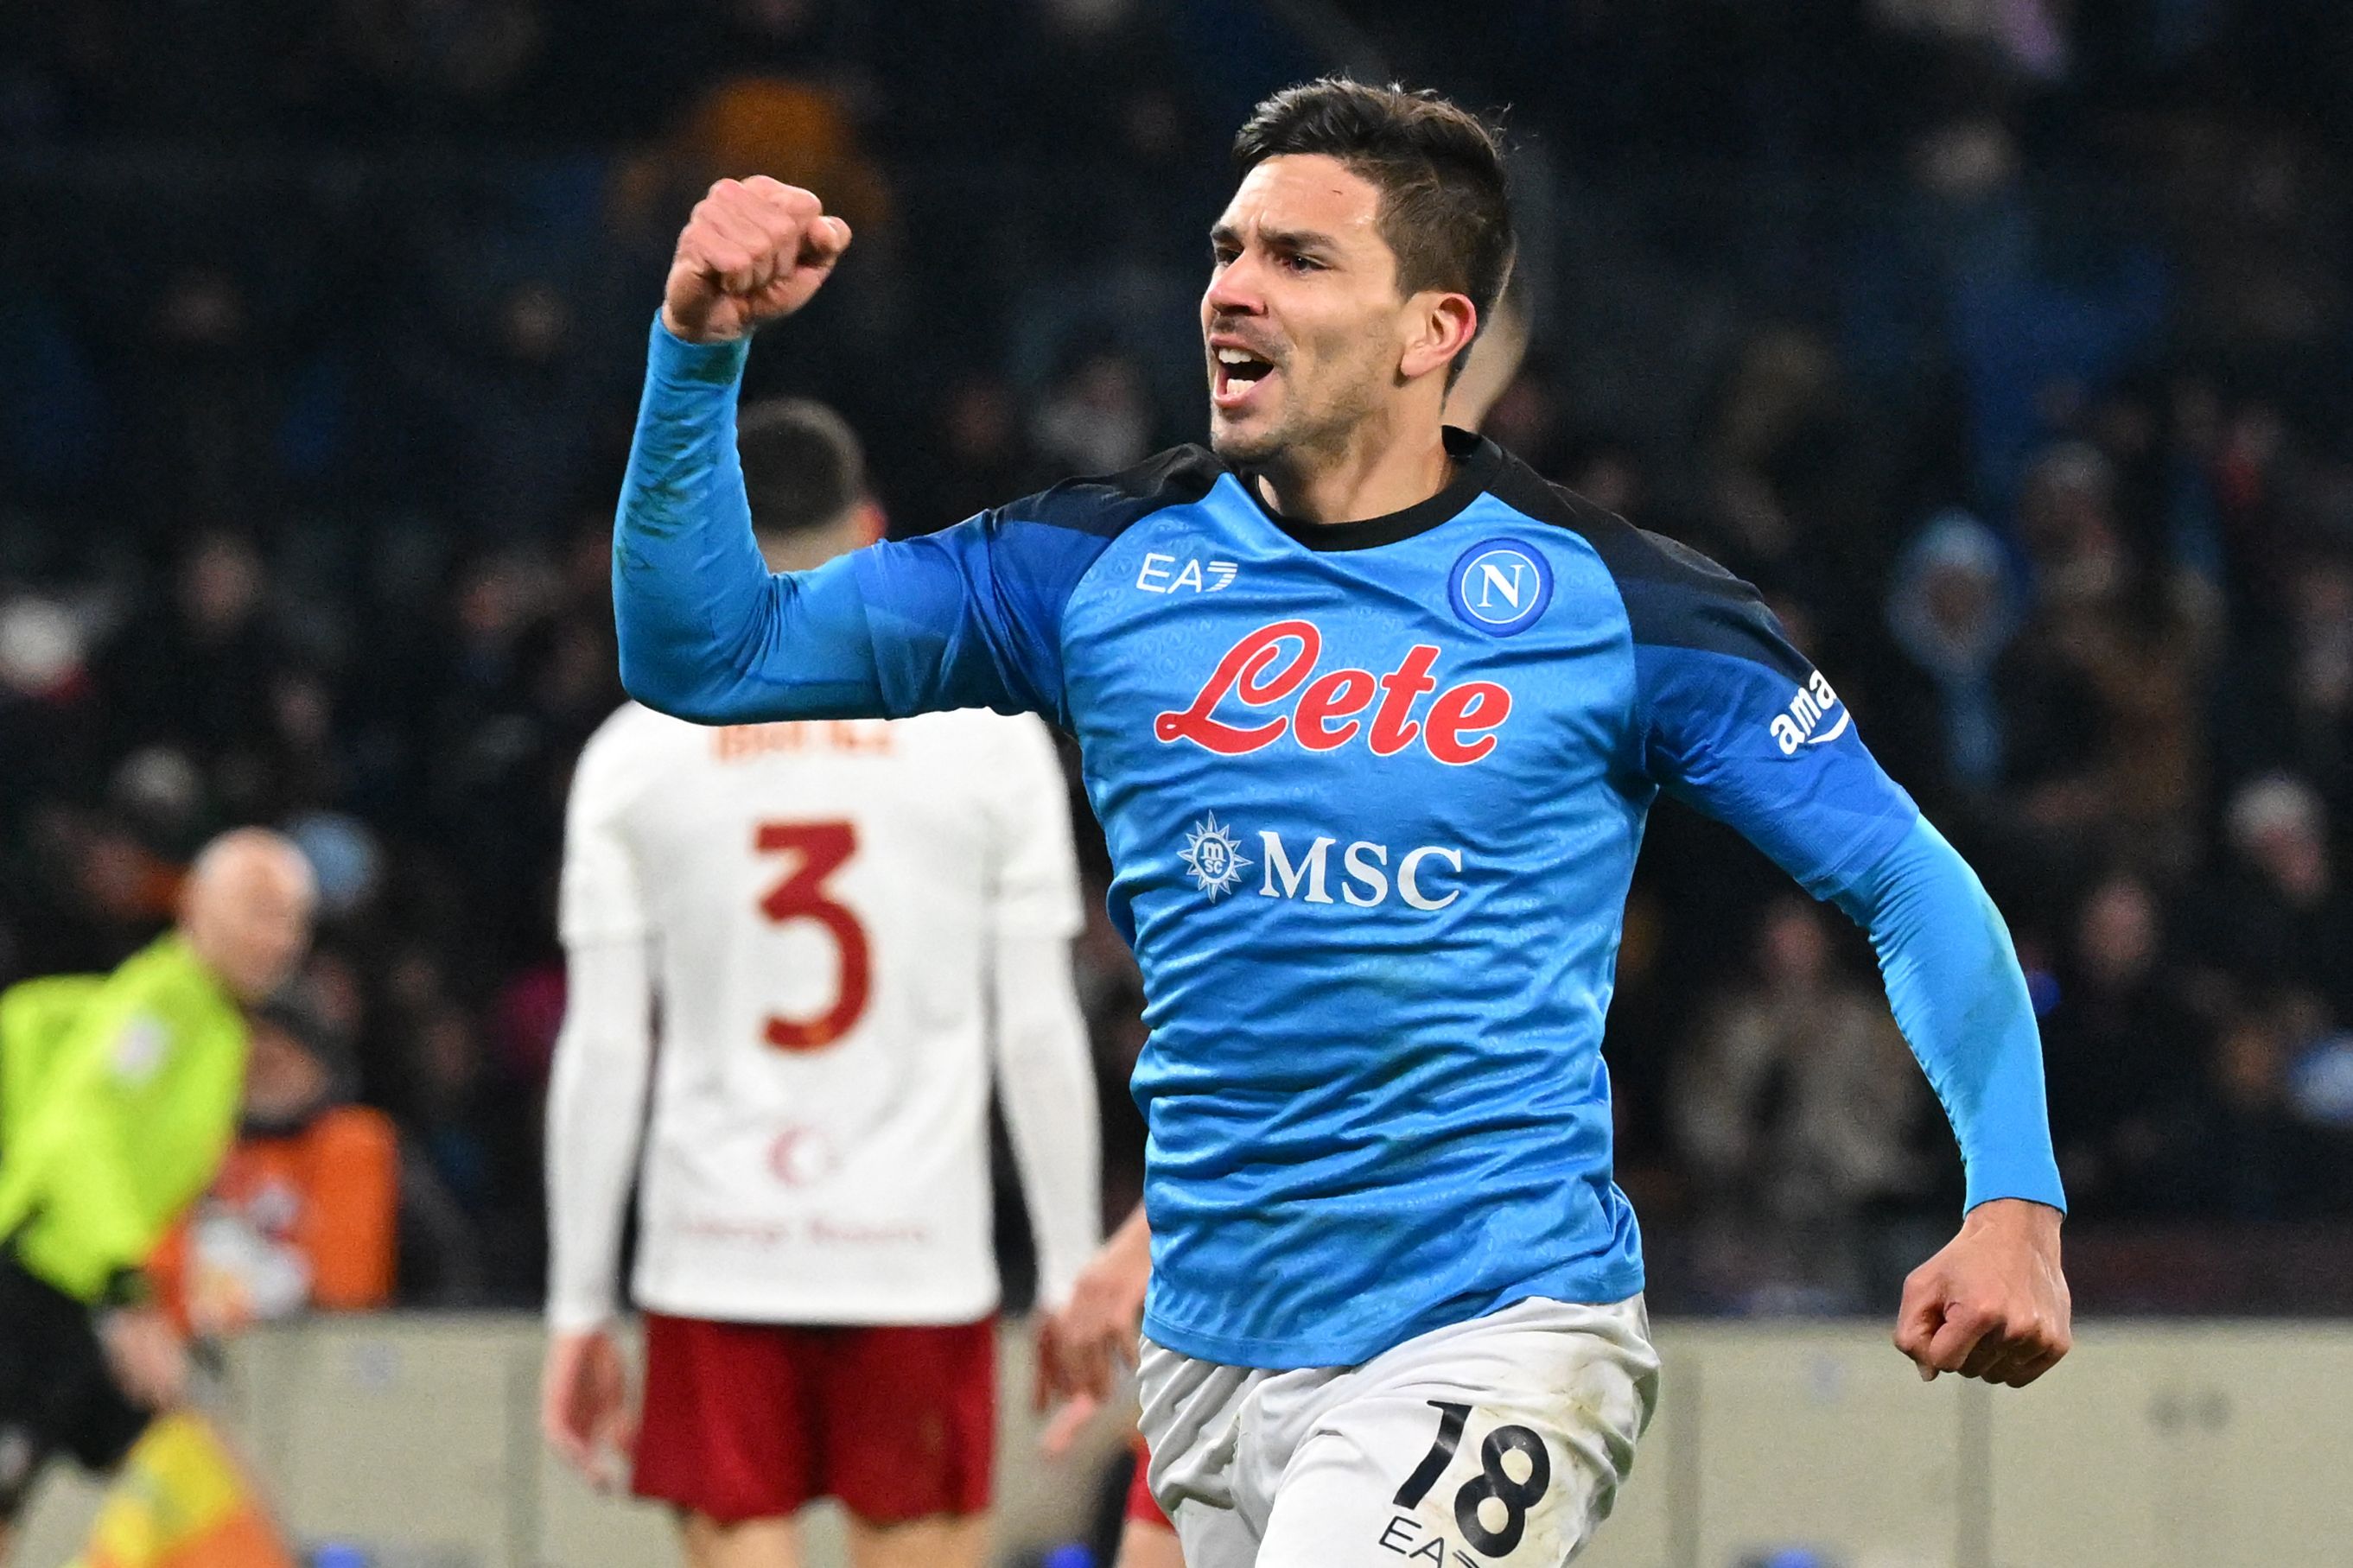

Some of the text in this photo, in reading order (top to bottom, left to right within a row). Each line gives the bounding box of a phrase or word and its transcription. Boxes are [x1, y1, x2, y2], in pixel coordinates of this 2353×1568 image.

[1136, 553, 1238, 594] EA7
[1477, 563, 1526, 608] N
[1154, 619, 1513, 766] Lete
[1258, 830, 1464, 911] MSC
[754, 818, 870, 1054] 3
[1393, 1400, 1550, 1558] 18
[1378, 1515, 1481, 1568] EA
